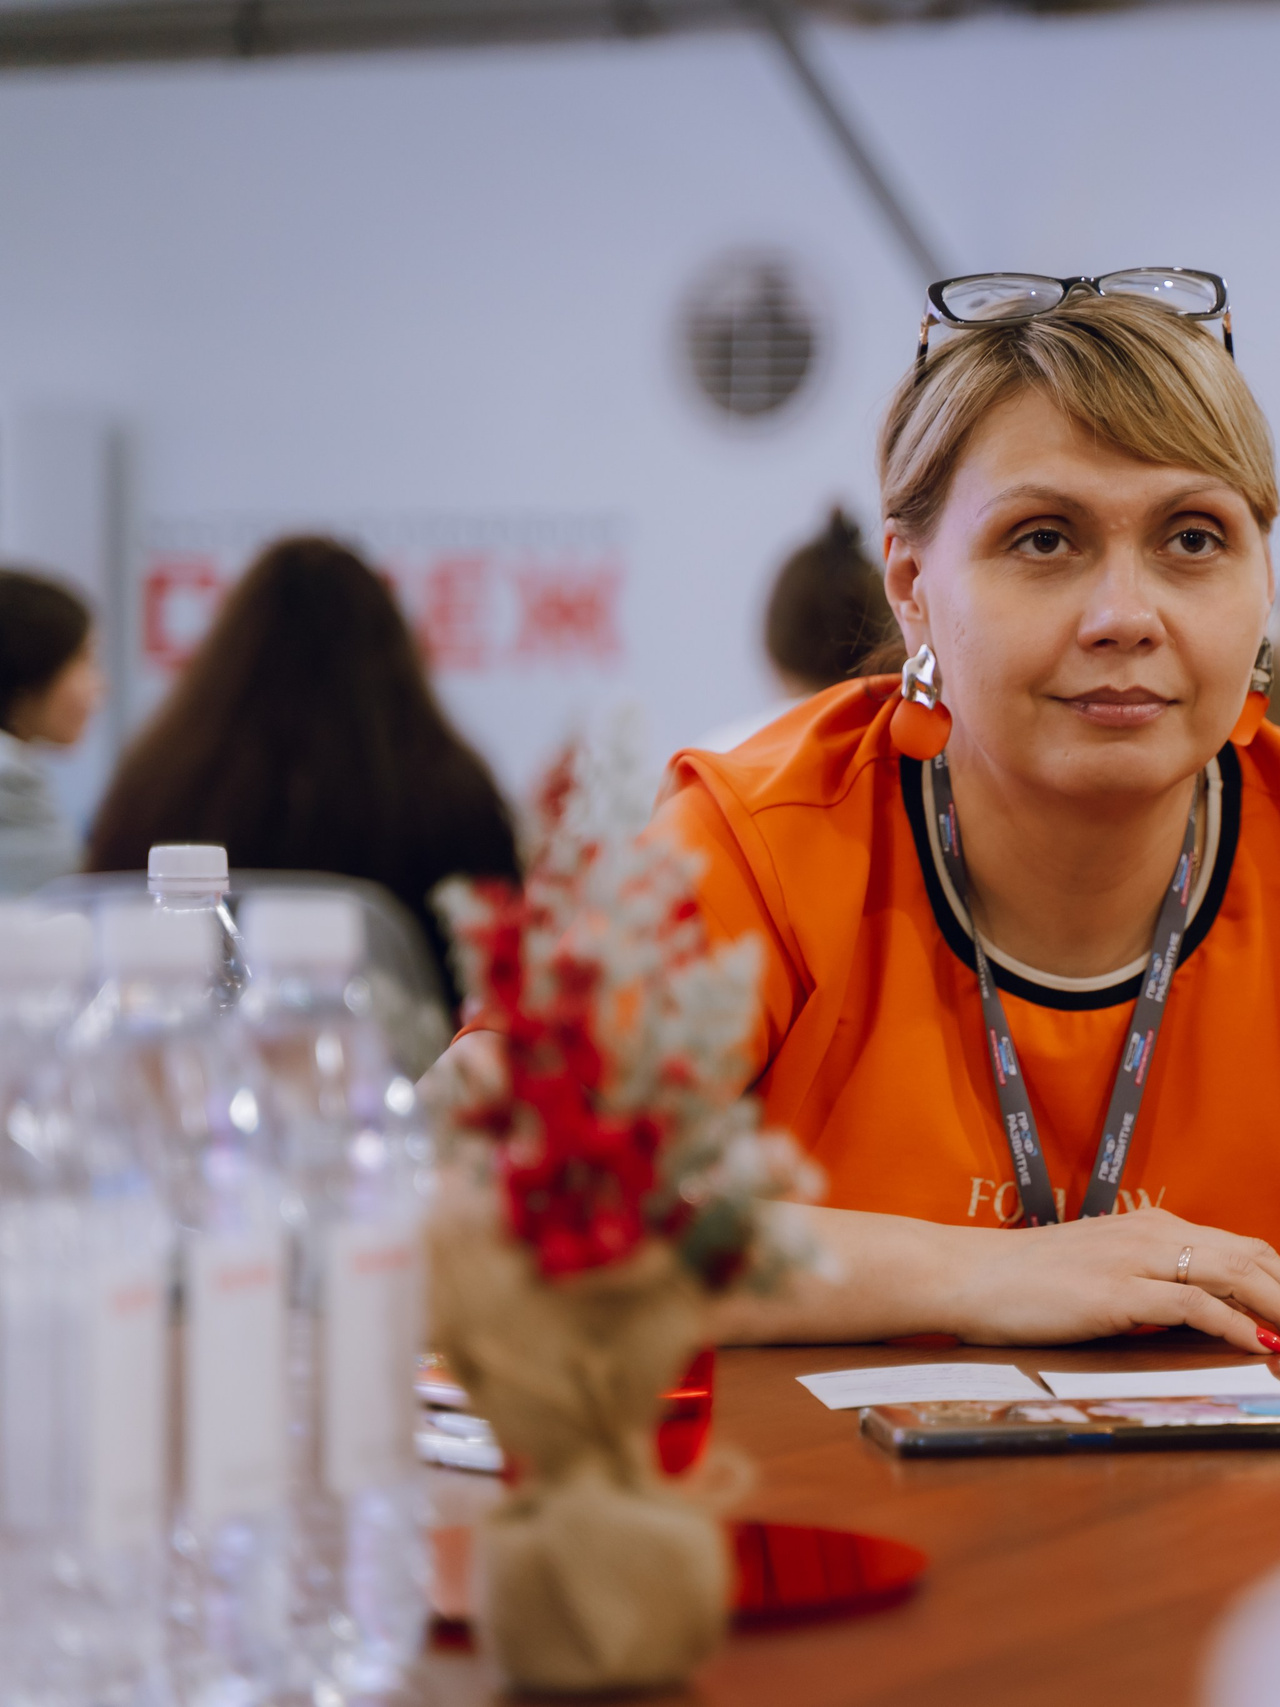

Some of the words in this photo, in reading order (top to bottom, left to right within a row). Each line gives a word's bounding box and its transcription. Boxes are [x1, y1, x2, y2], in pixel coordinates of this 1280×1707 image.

[140, 553, 626, 676] СЕЖ
[1155, 932, 1180, 1002] РАЗВИТИЕ
[1006, 1114, 1031, 1186] РАЗВИТИЕ
[1108, 1112, 1134, 1184] РАЗВИТИЕ
